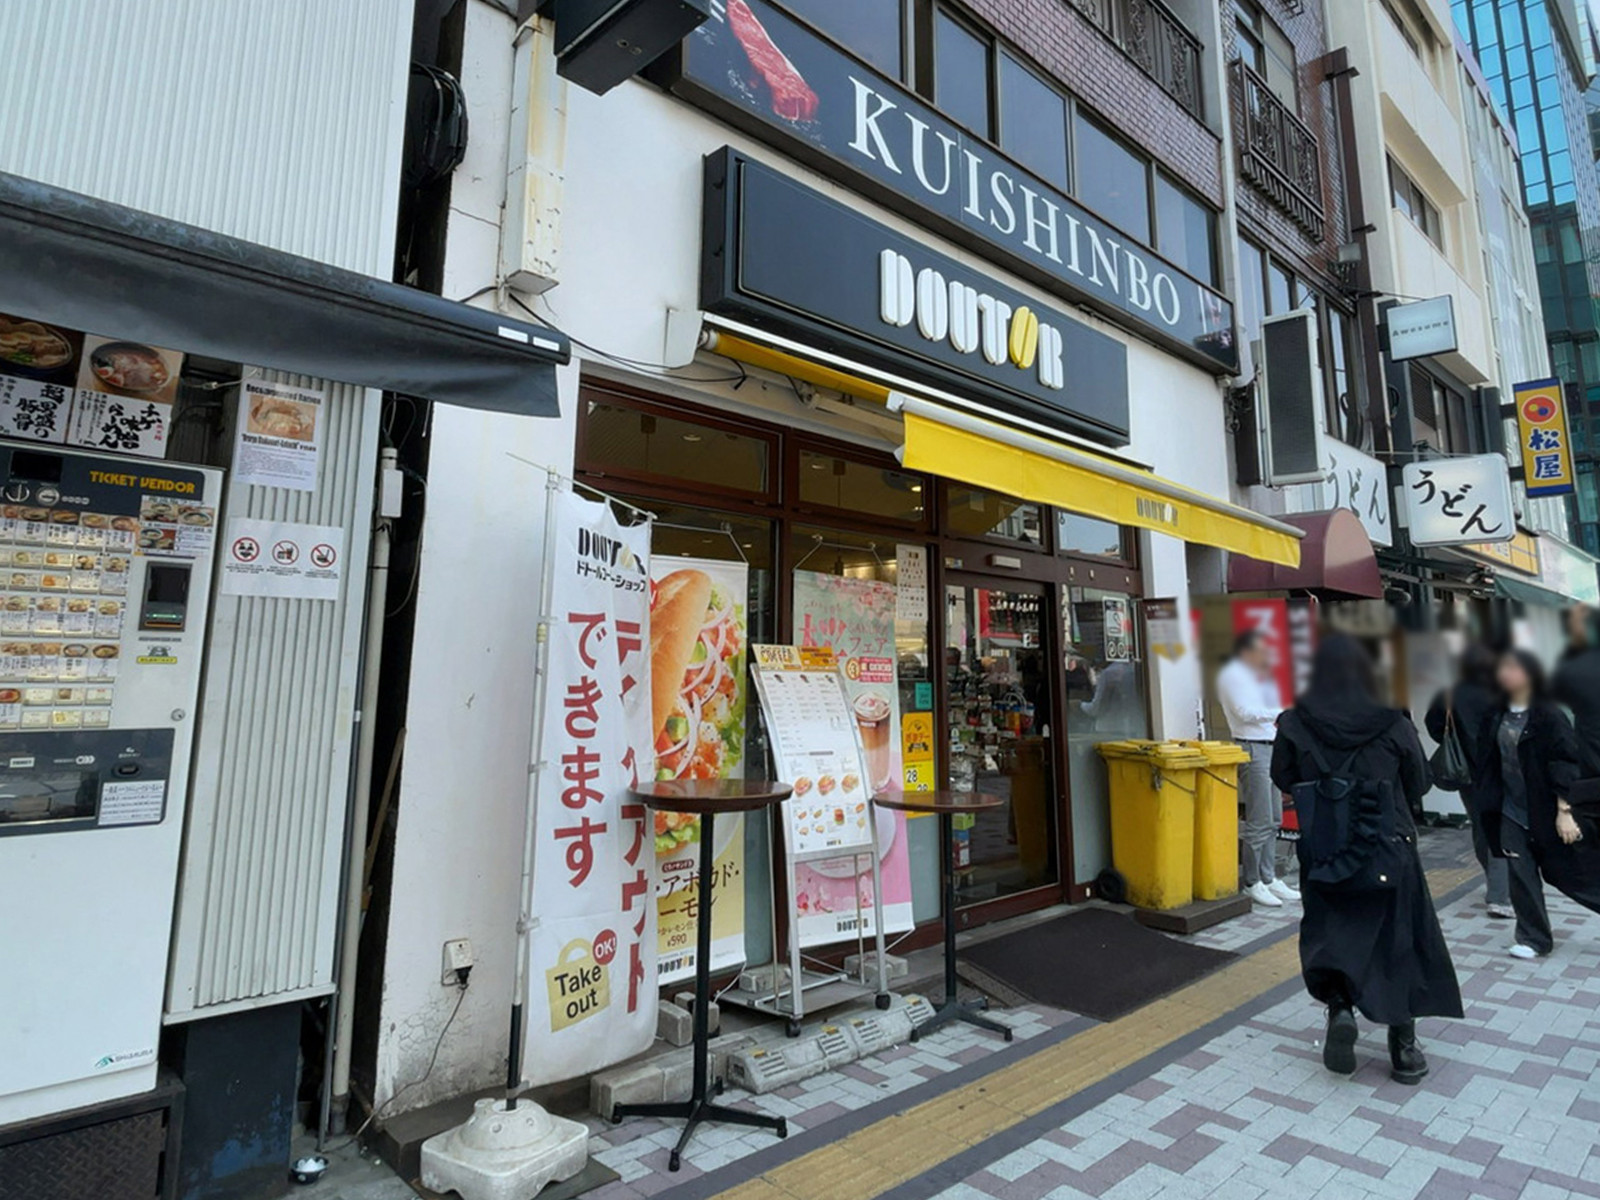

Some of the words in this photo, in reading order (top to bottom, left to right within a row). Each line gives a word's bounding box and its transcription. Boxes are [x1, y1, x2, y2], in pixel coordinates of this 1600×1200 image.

[848, 76, 1181, 325] KUISHINBO
[880, 248, 1063, 390] DOUTOR
[89, 470, 137, 487] TICKET
[139, 476, 196, 494] VENDOR
[1528, 428, 1563, 480] 松屋
[1324, 453, 1388, 526] うどん
[1411, 468, 1502, 535] うどん
[553, 611, 608, 888] できます
[593, 934, 618, 959] OK!
[554, 962, 603, 997] Take
[566, 990, 599, 1020] out
